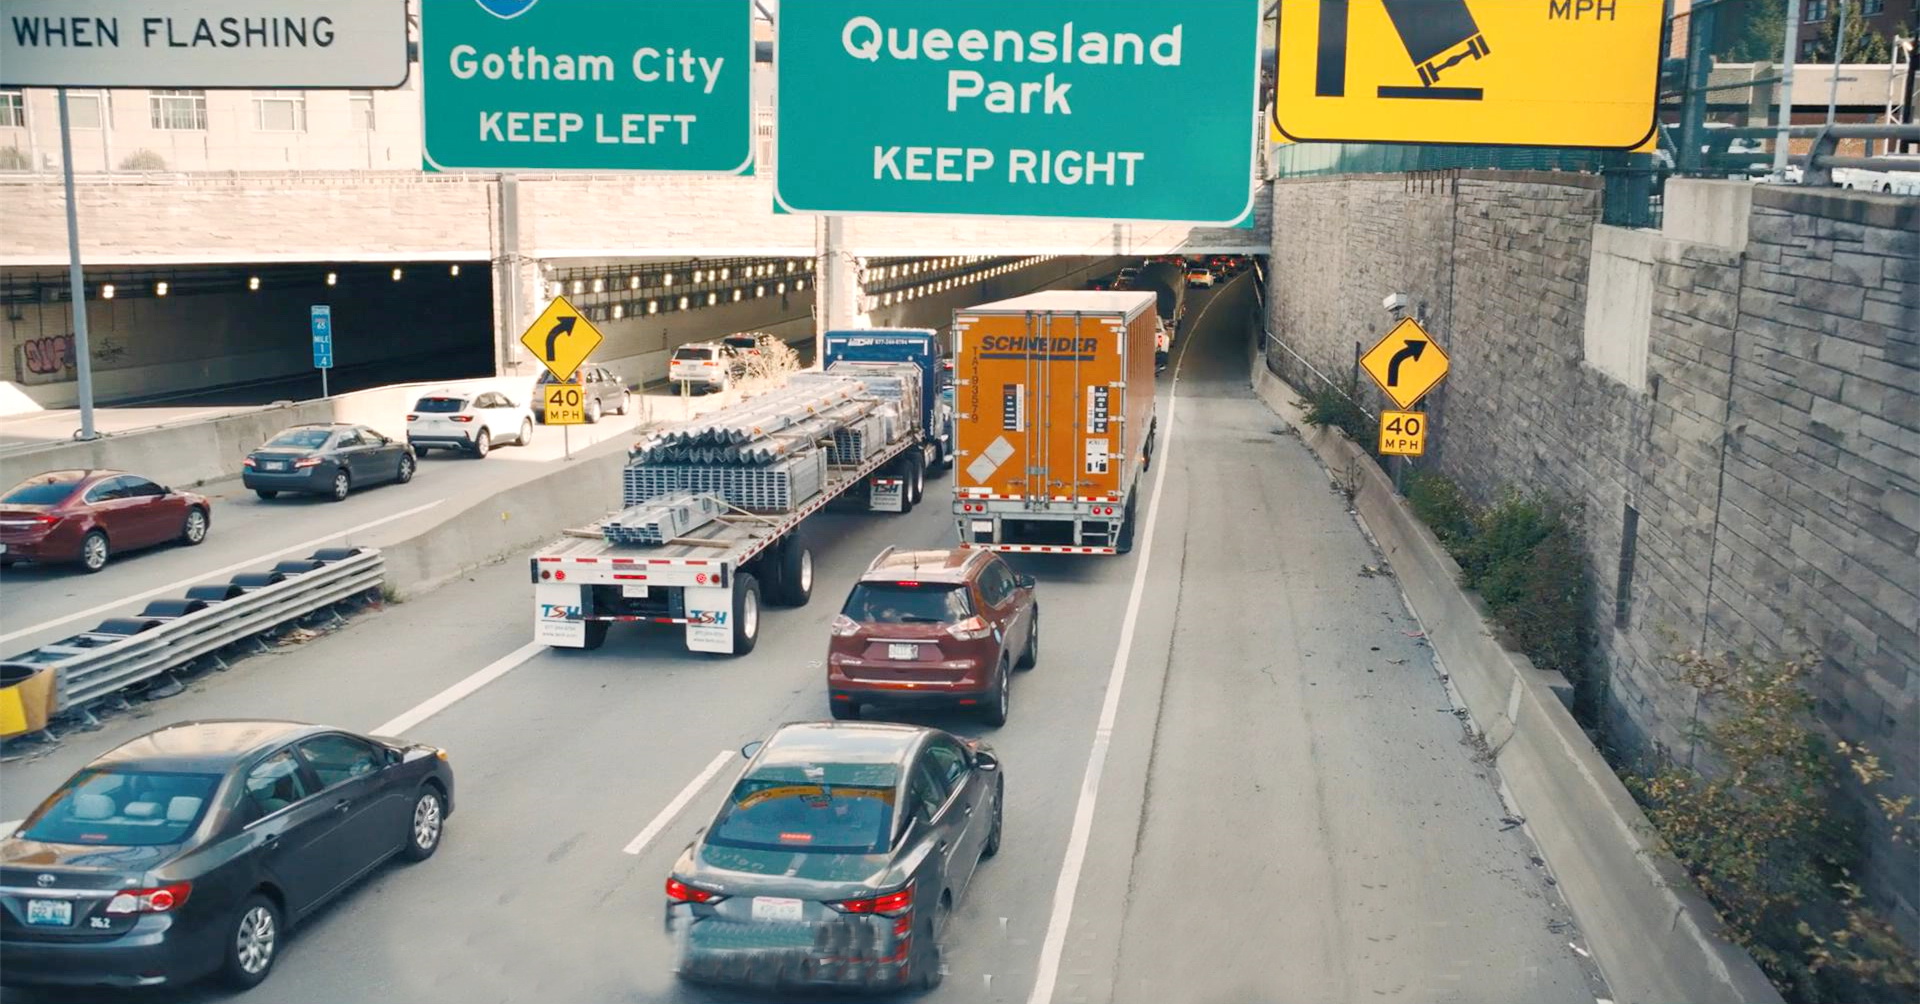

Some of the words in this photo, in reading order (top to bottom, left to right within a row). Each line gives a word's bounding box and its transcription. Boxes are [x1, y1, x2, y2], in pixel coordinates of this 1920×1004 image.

[1549, 0, 1616, 21] MPH
[11, 16, 119, 48] WHEN
[143, 16, 335, 48] FLASHING
[842, 16, 1183, 66] Queensland
[450, 45, 614, 81] Gotham
[633, 47, 724, 94] City
[948, 70, 1072, 115] Park
[479, 112, 583, 142] KEEP
[596, 114, 697, 145] LEFT
[874, 146, 994, 183] KEEP
[1009, 149, 1145, 187] RIGHT
[314, 335, 329, 343] MILE
[981, 335, 1098, 352] SCHNEIDER
[550, 390, 578, 406] 40
[551, 411, 579, 420] MPH
[1386, 417, 1420, 436] 40
[1385, 439, 1418, 450] MPH
